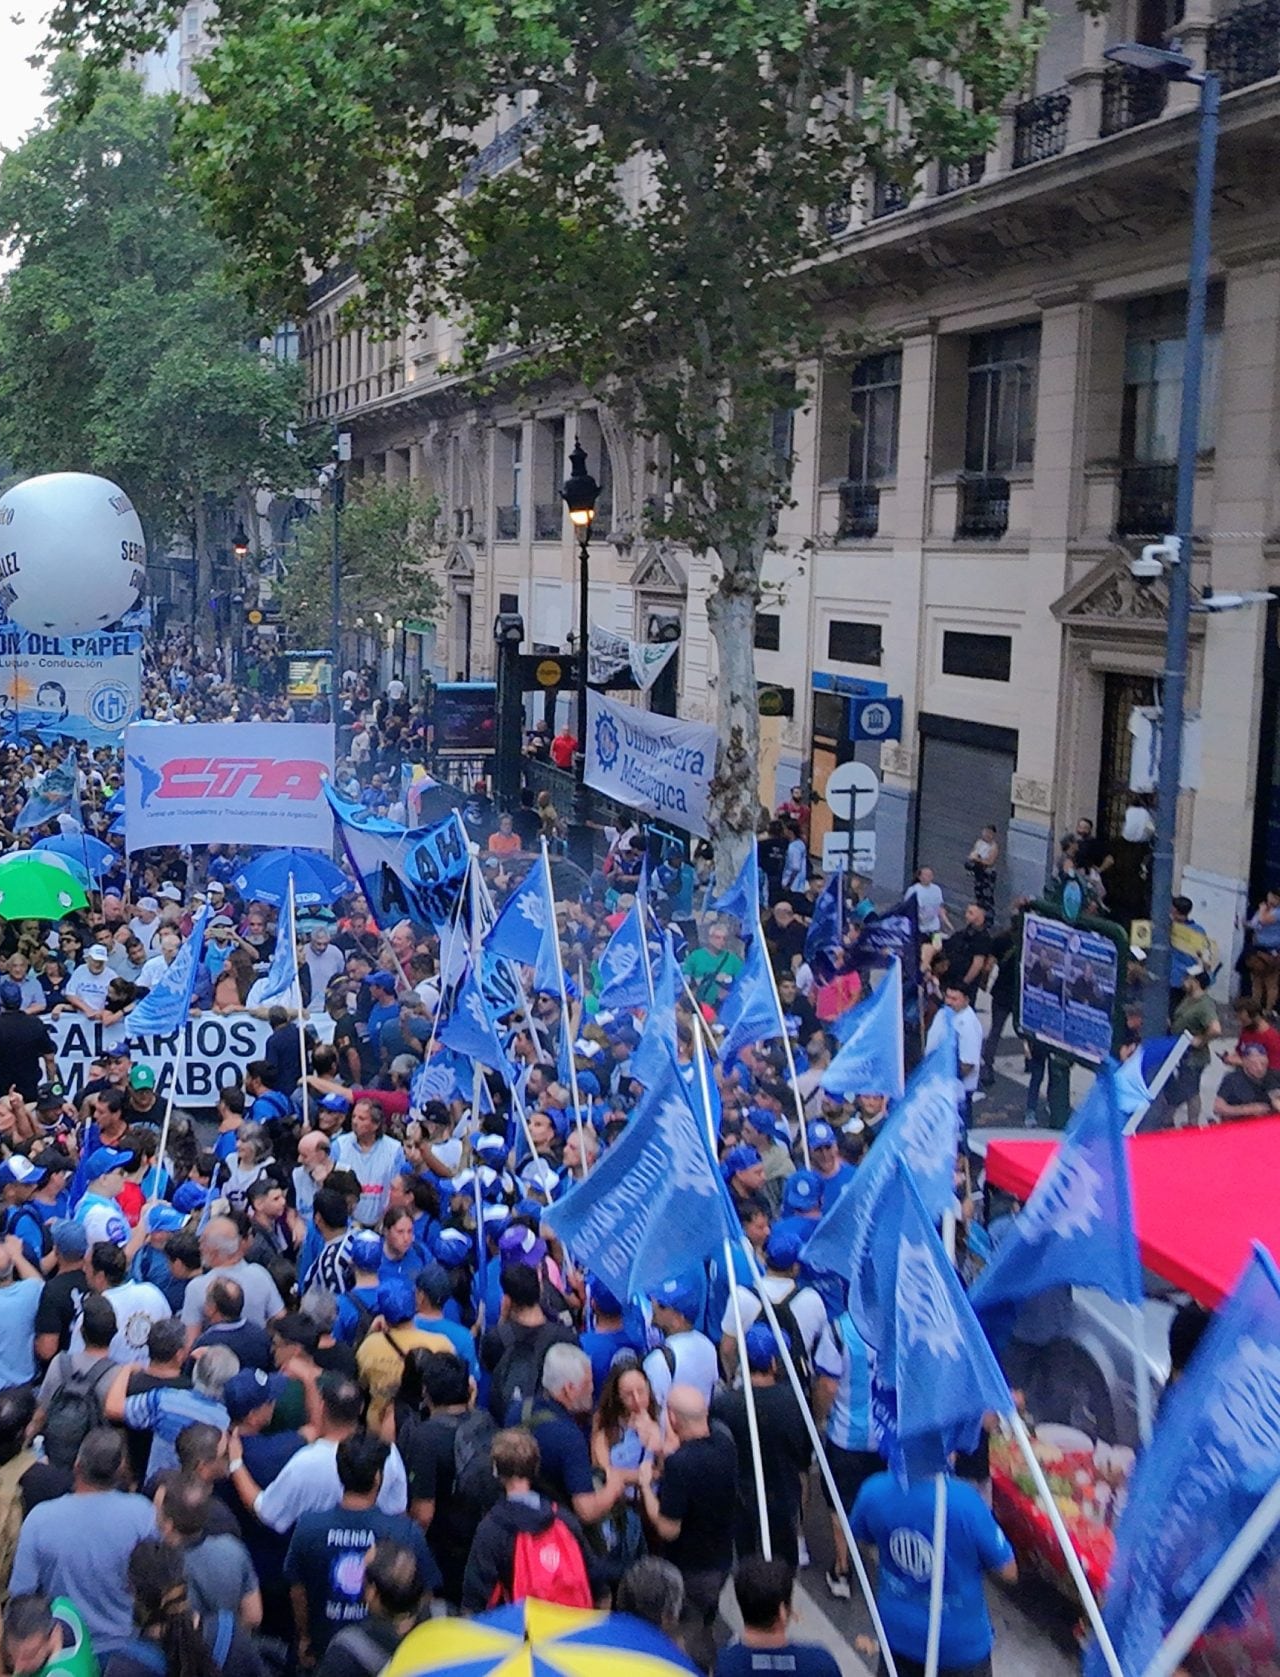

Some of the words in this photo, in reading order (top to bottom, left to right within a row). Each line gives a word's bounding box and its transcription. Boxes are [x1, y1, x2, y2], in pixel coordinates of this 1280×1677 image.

[27, 633, 65, 656] DEL
[71, 635, 134, 656] PAPEL
[38, 657, 103, 668] Conducción
[154, 757, 330, 801] CTA
[327, 1528, 375, 1547] PRENSA
